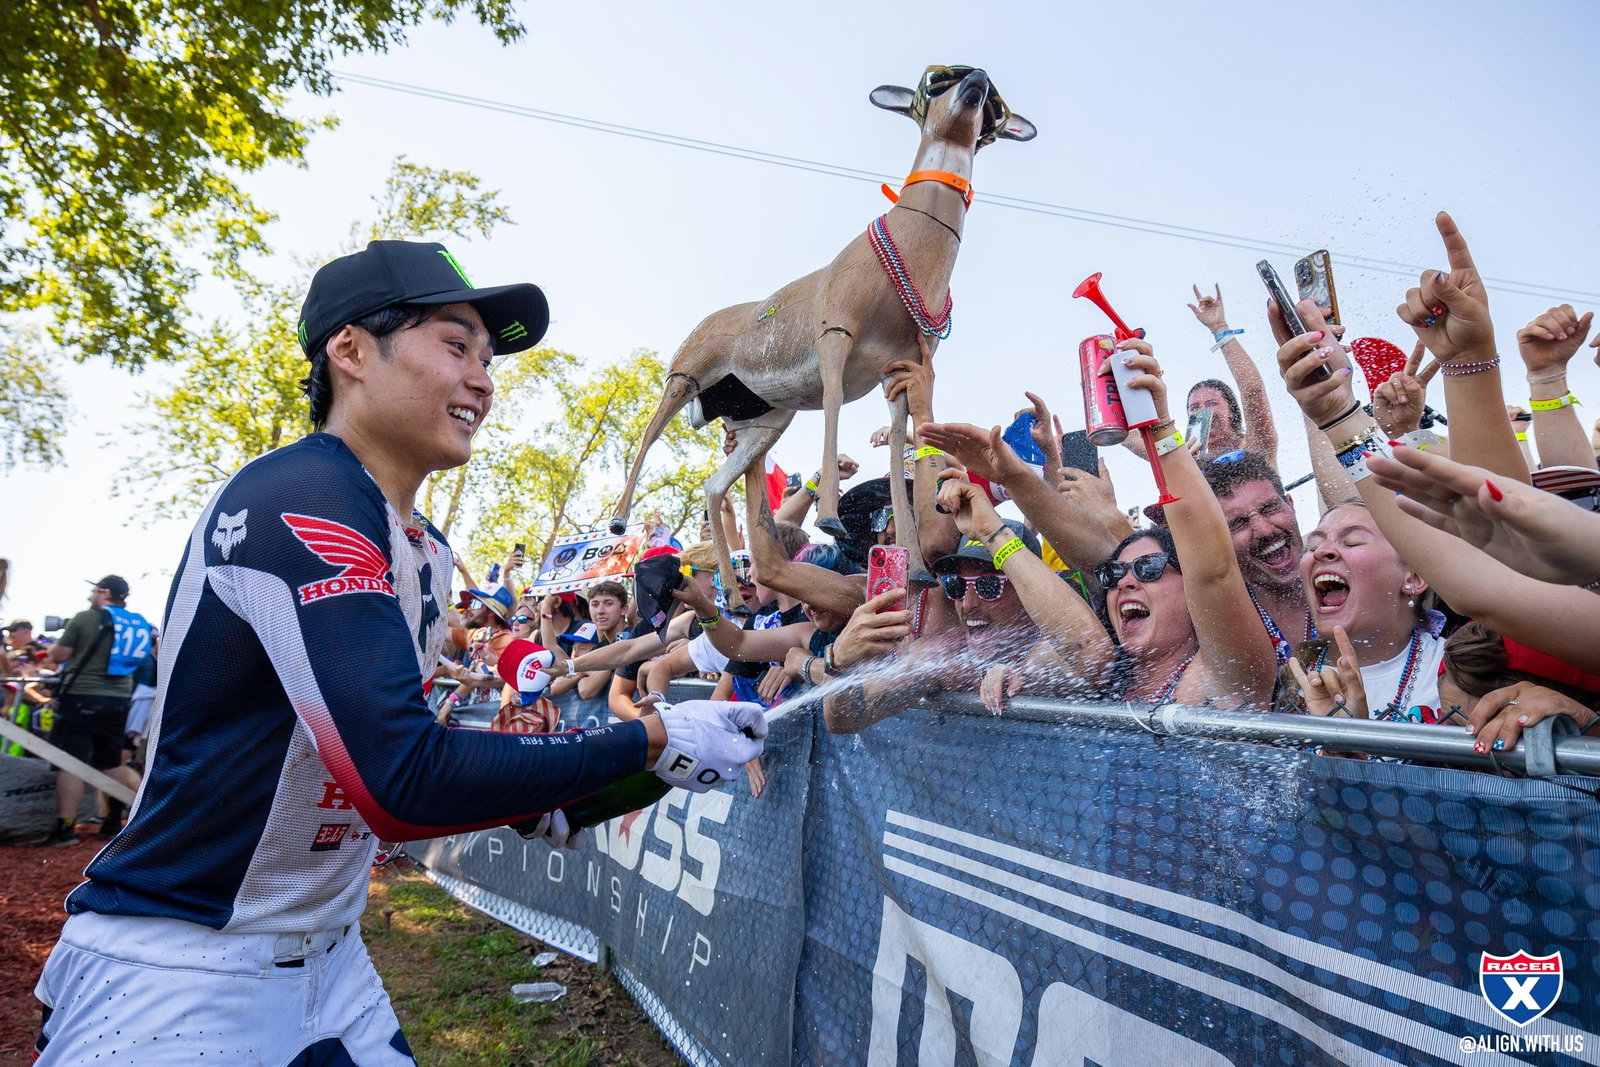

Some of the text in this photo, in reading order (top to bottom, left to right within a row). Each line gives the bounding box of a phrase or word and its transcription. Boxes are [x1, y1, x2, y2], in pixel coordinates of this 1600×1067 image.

[300, 577, 396, 602] HONDA
[585, 726, 613, 737] LAND
[518, 736, 543, 745] FREE
[548, 736, 569, 745] THE
